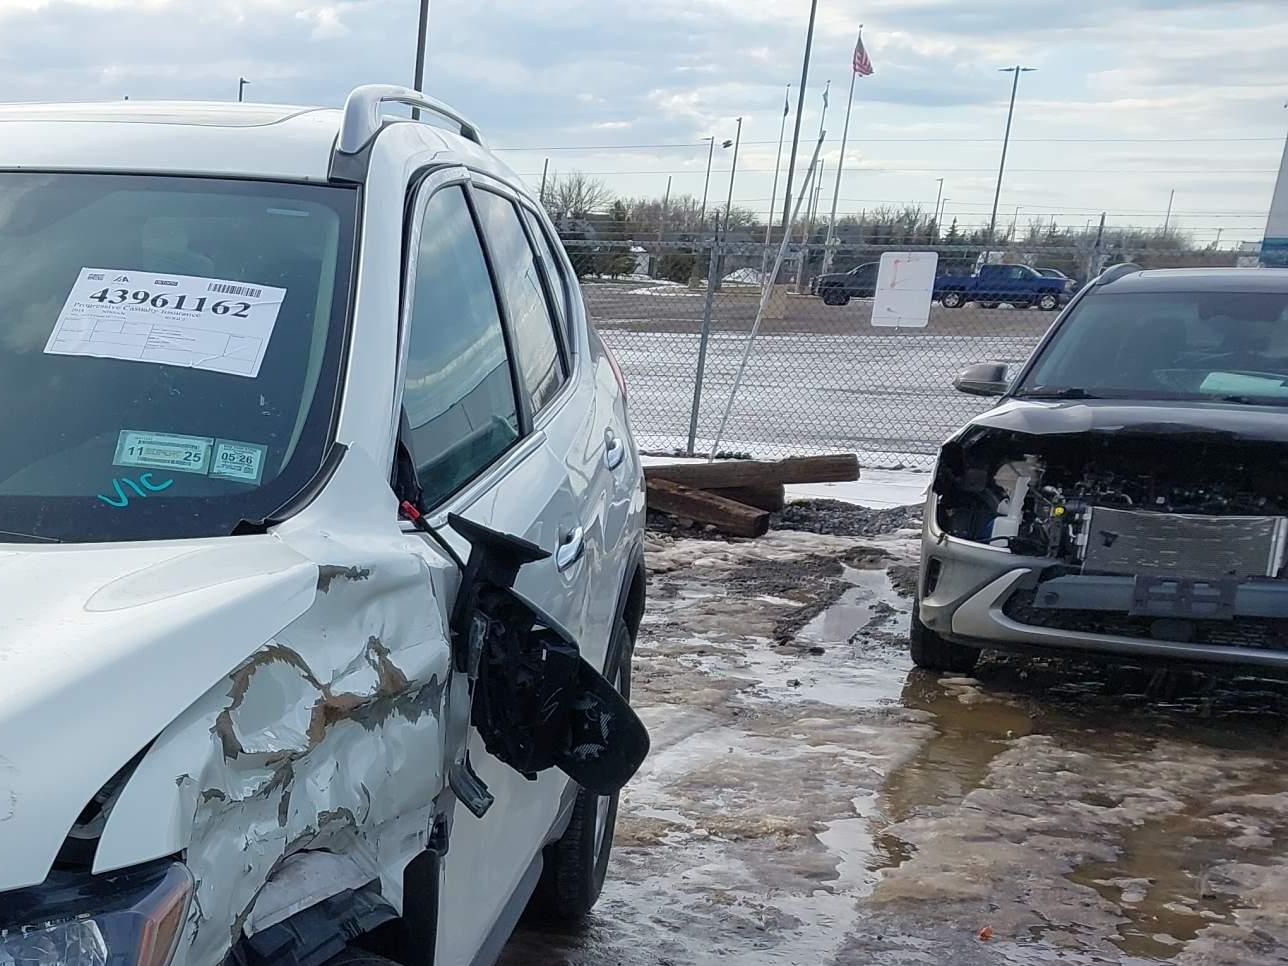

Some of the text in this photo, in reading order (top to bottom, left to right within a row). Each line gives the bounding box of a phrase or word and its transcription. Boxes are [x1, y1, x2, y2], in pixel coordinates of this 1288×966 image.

[73, 302, 121, 310] Progressive
[123, 304, 158, 314] Casualty
[89, 287, 252, 318] 43961162
[128, 446, 144, 456] 11
[183, 451, 202, 463] 25
